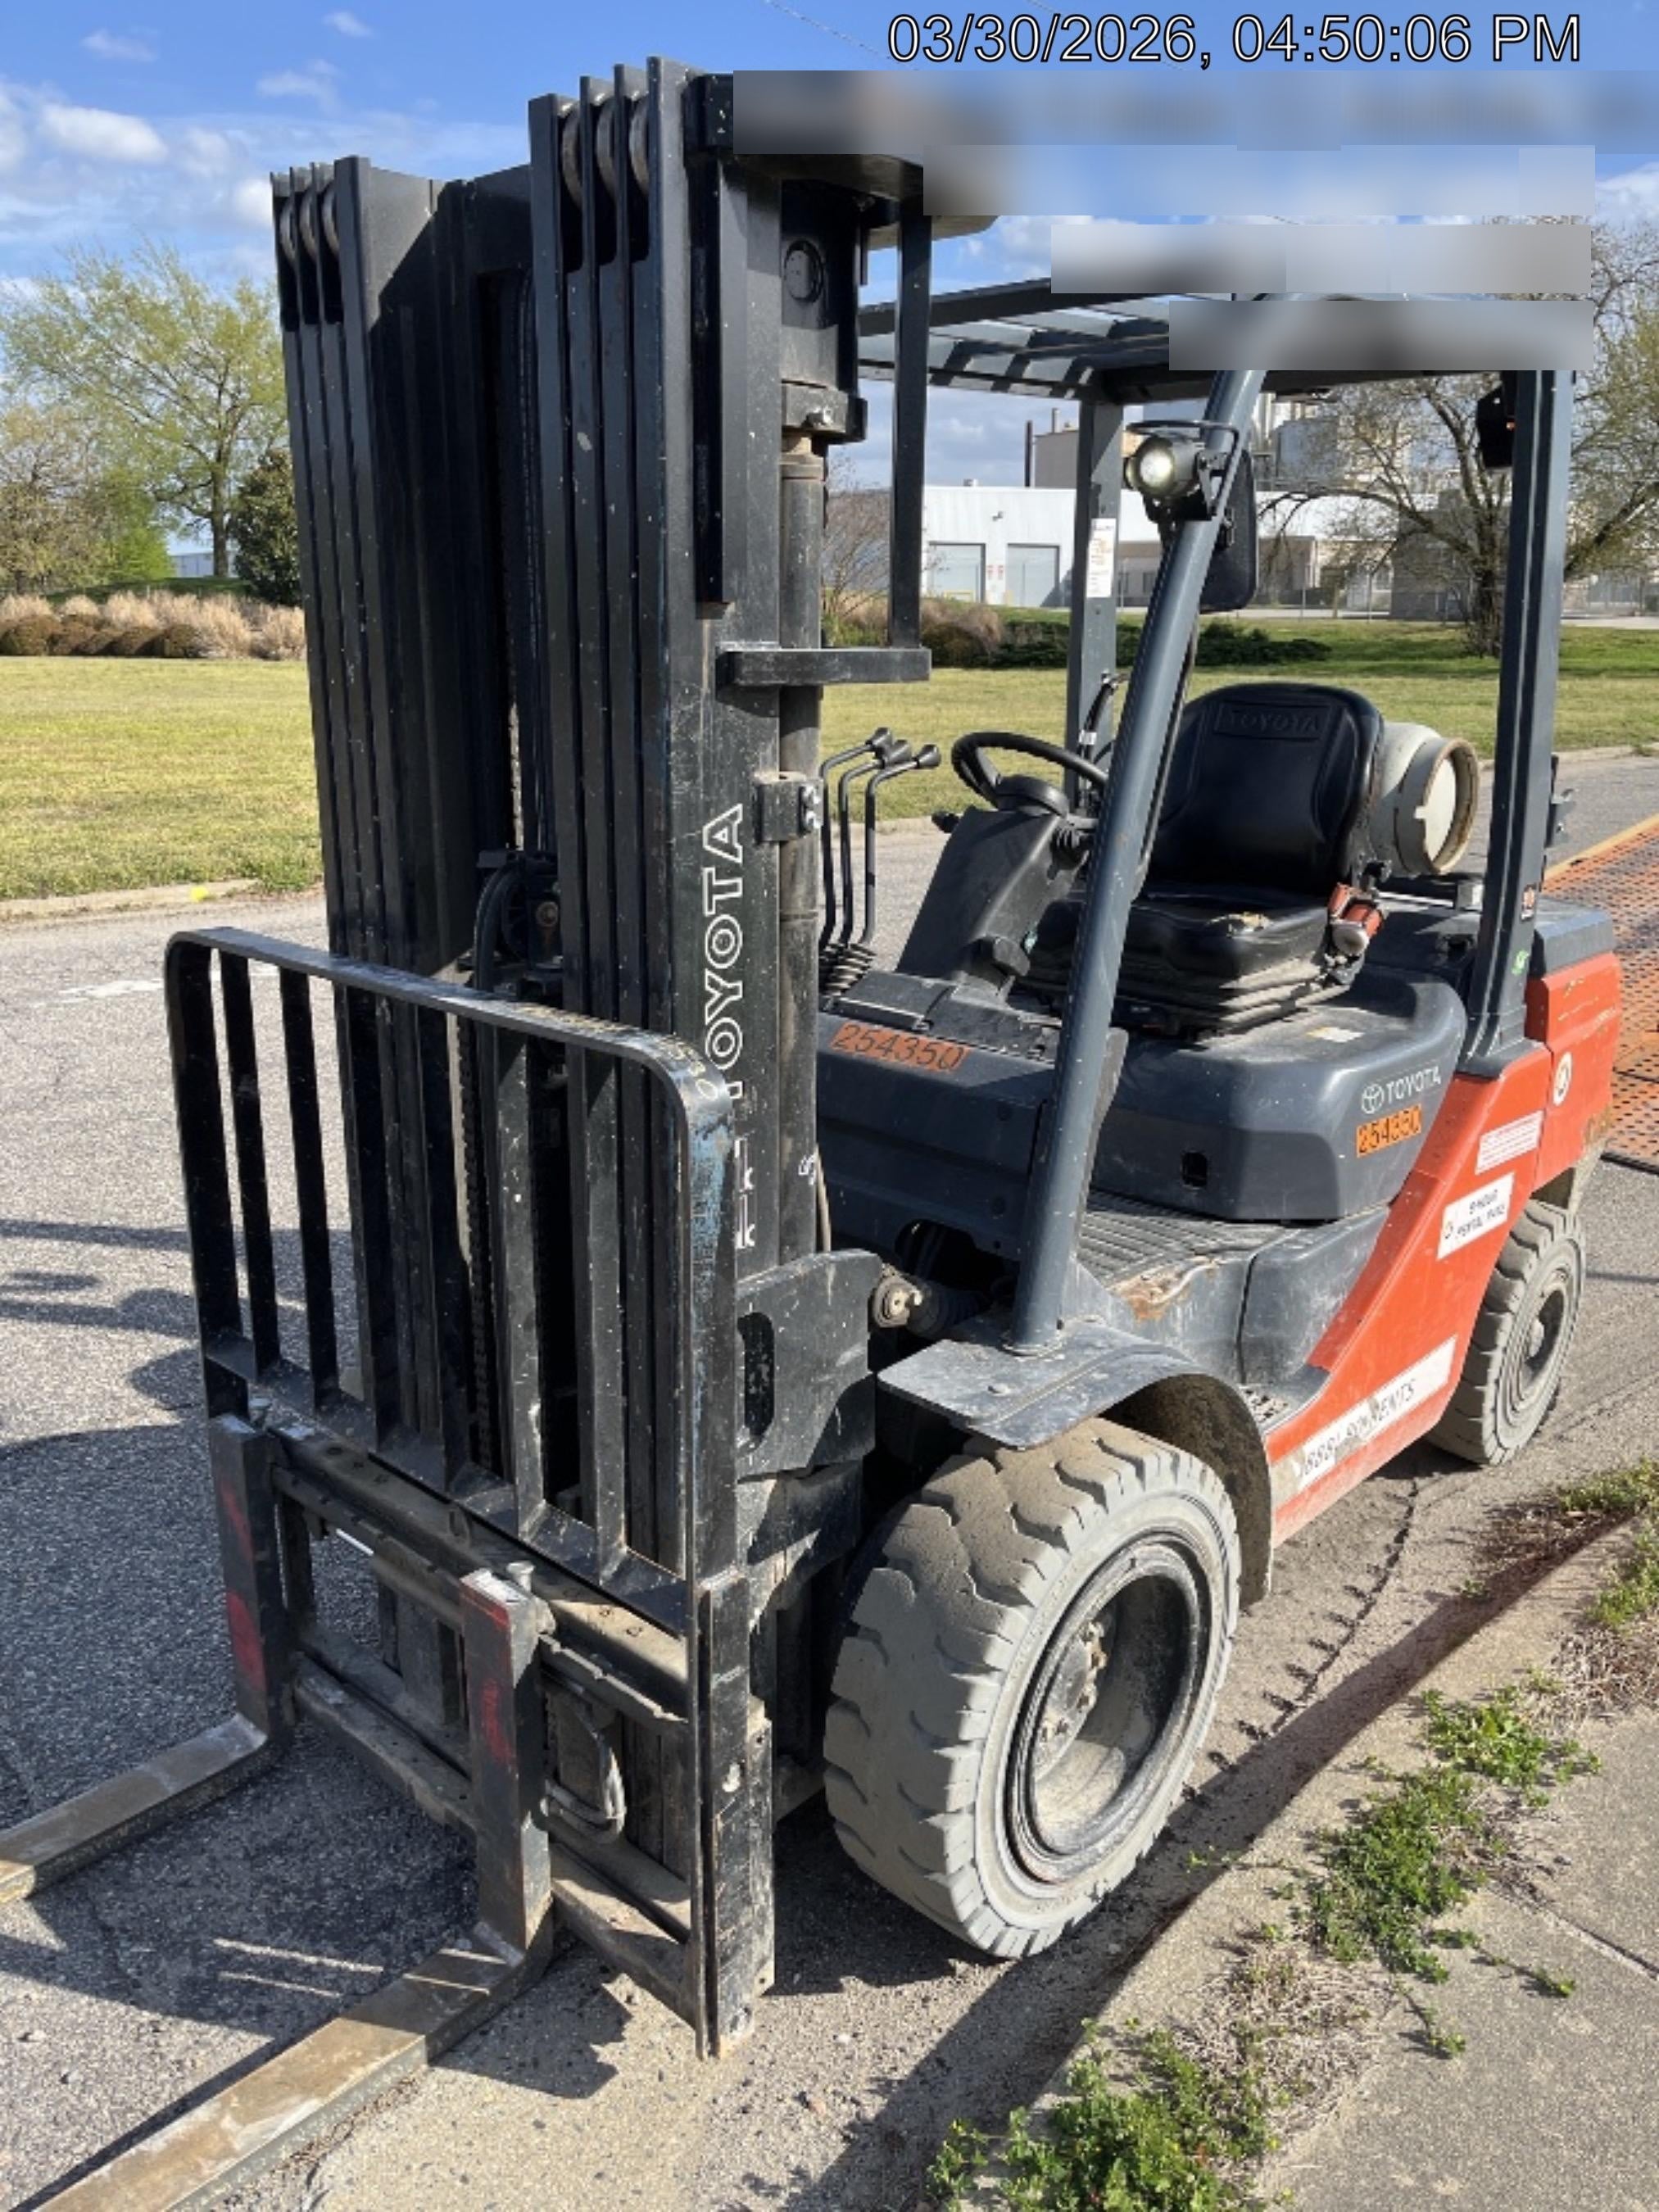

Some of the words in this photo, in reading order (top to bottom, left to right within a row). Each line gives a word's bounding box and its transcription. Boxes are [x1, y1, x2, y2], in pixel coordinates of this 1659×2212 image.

[1231, 709, 1320, 734] TOYOTA
[832, 1024, 964, 1071] 254350
[1385, 1065, 1442, 1104] TOYOTA
[1358, 1104, 1421, 1154] 254350
